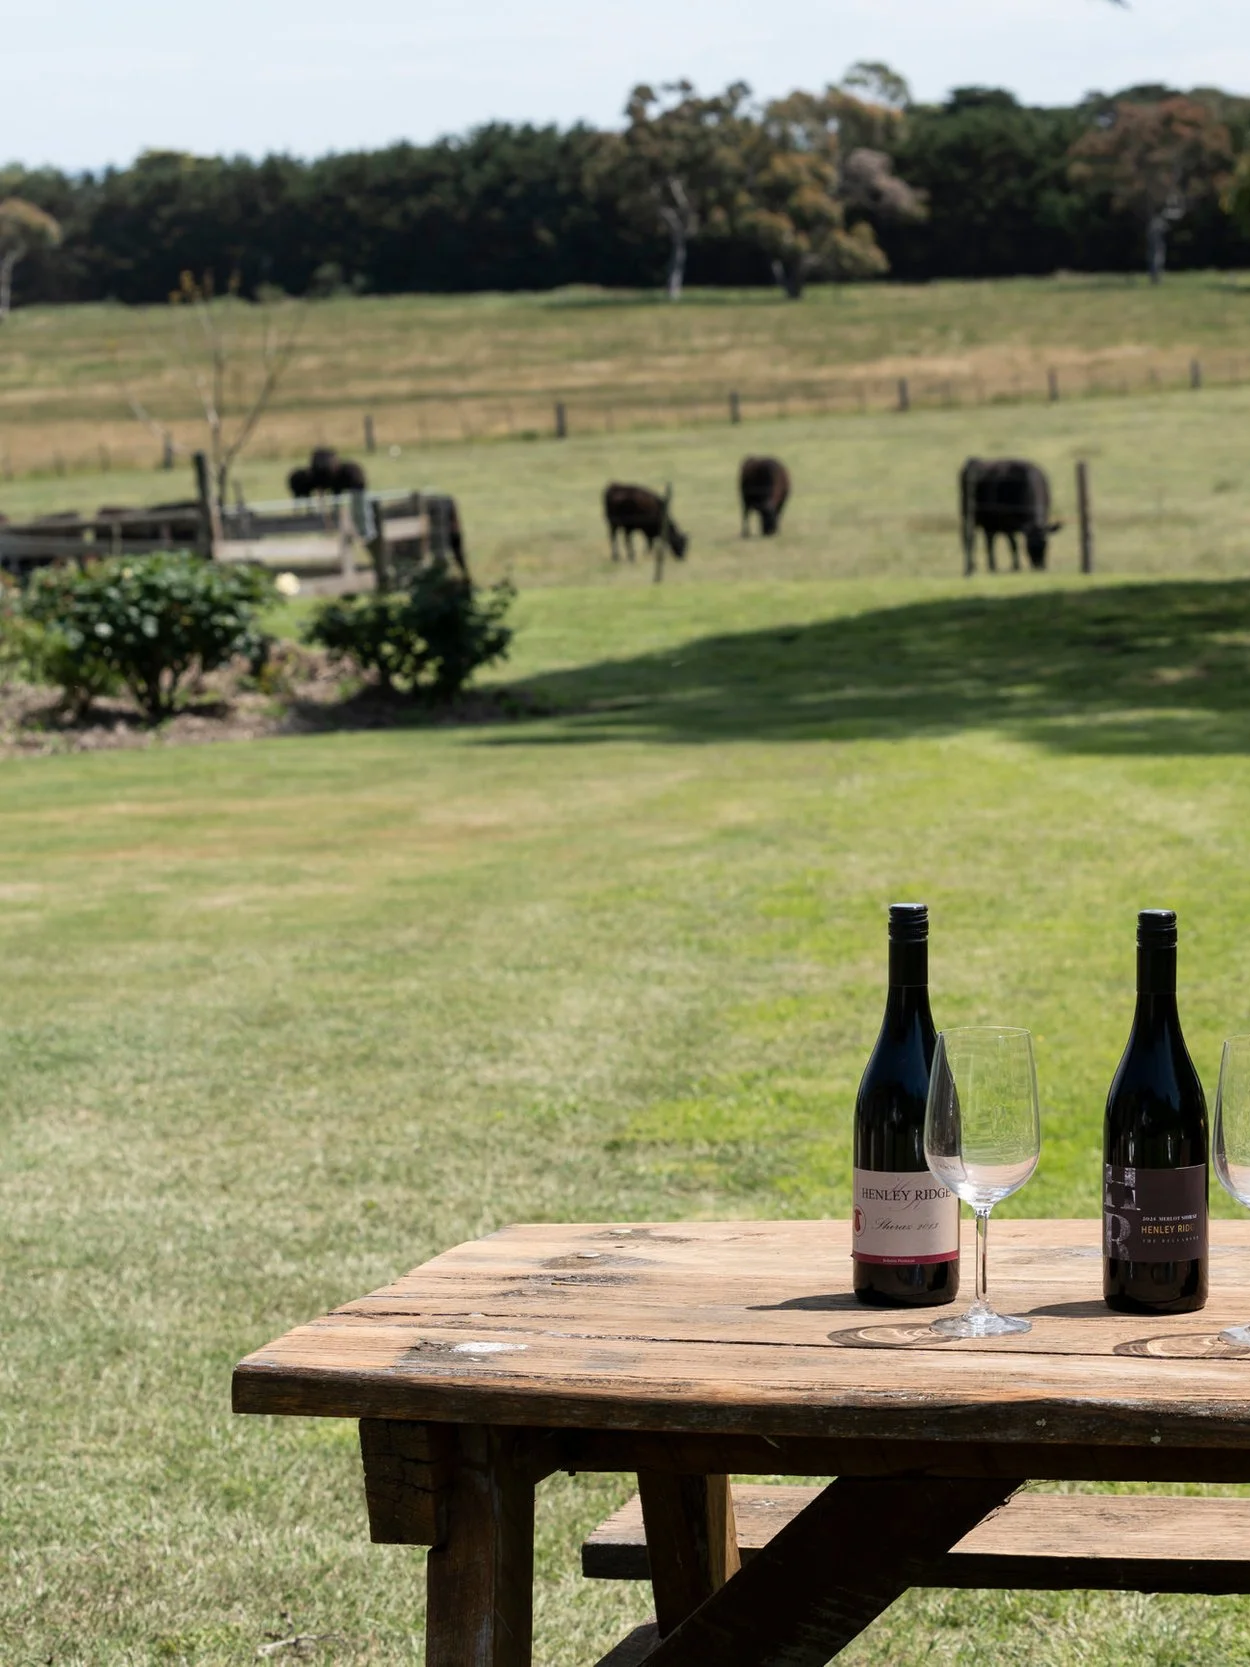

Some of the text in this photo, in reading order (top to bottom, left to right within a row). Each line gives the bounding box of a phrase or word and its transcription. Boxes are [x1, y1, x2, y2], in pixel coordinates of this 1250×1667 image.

[862, 1188, 911, 1200] HENLEY
[871, 1217, 912, 1233] Shiraz
[1141, 1224, 1175, 1235] HENLEY
